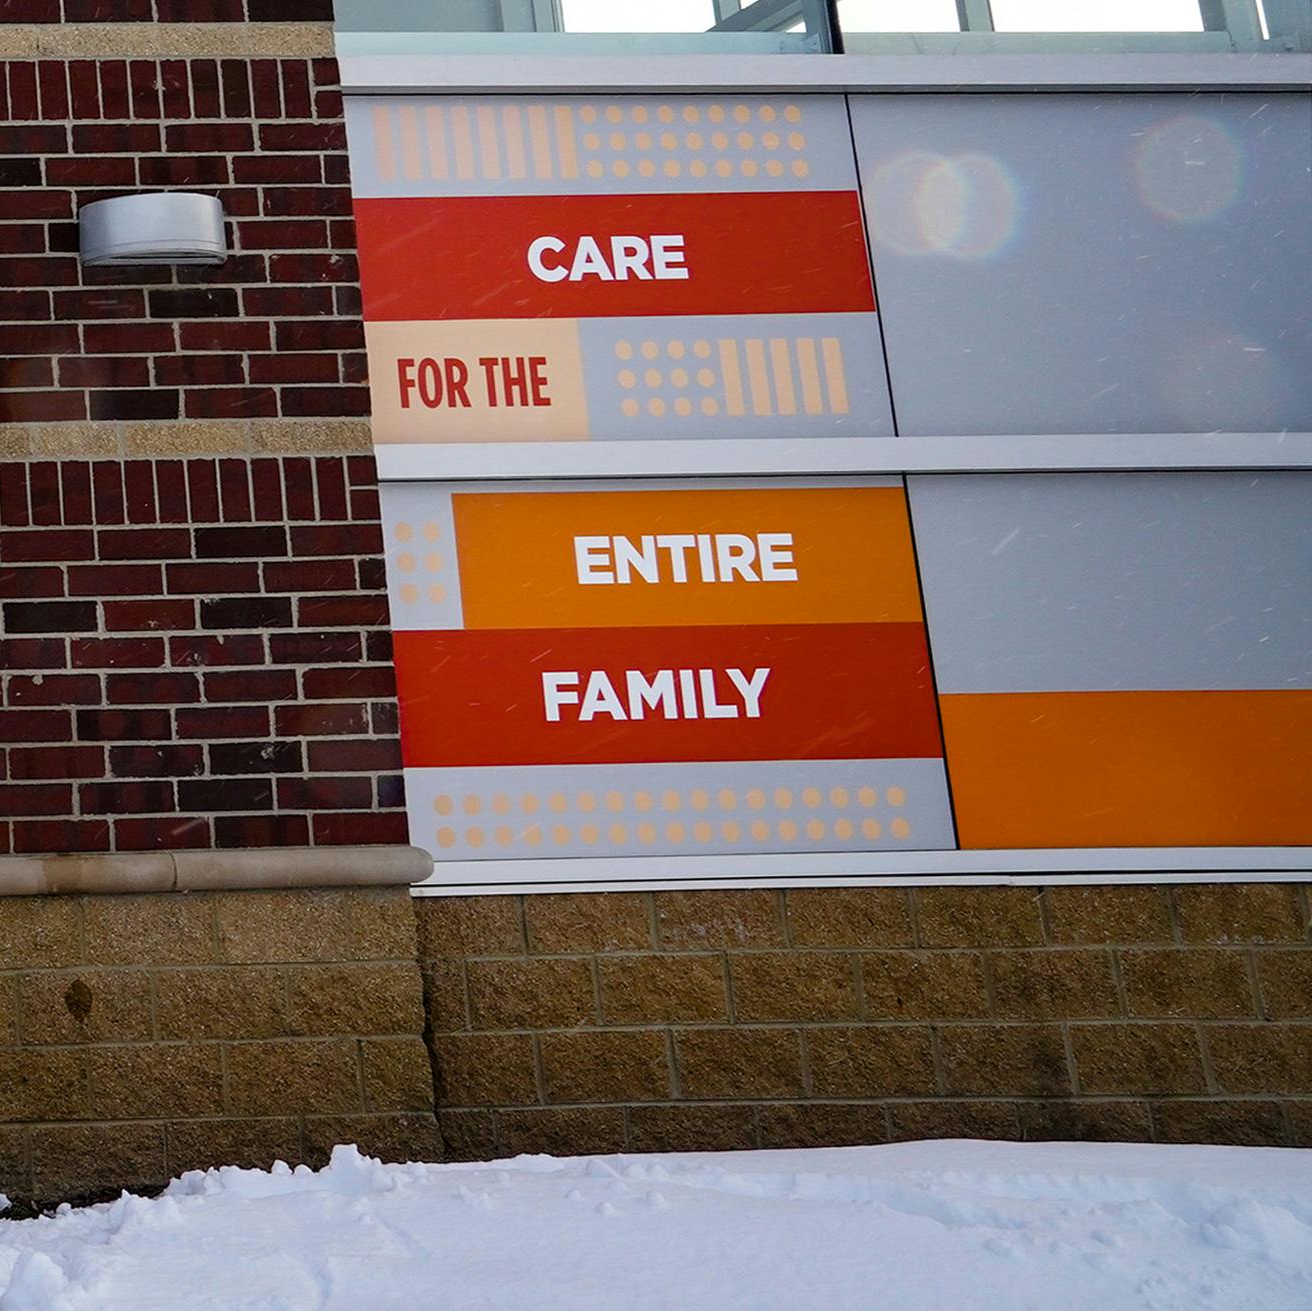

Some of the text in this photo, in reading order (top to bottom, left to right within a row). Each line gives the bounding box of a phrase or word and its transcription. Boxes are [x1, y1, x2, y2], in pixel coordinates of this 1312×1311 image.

[526, 234, 690, 283] CARE
[396, 356, 552, 409] FOR THE
[573, 532, 799, 586] ENTIRE
[541, 667, 772, 722] FAMILY
